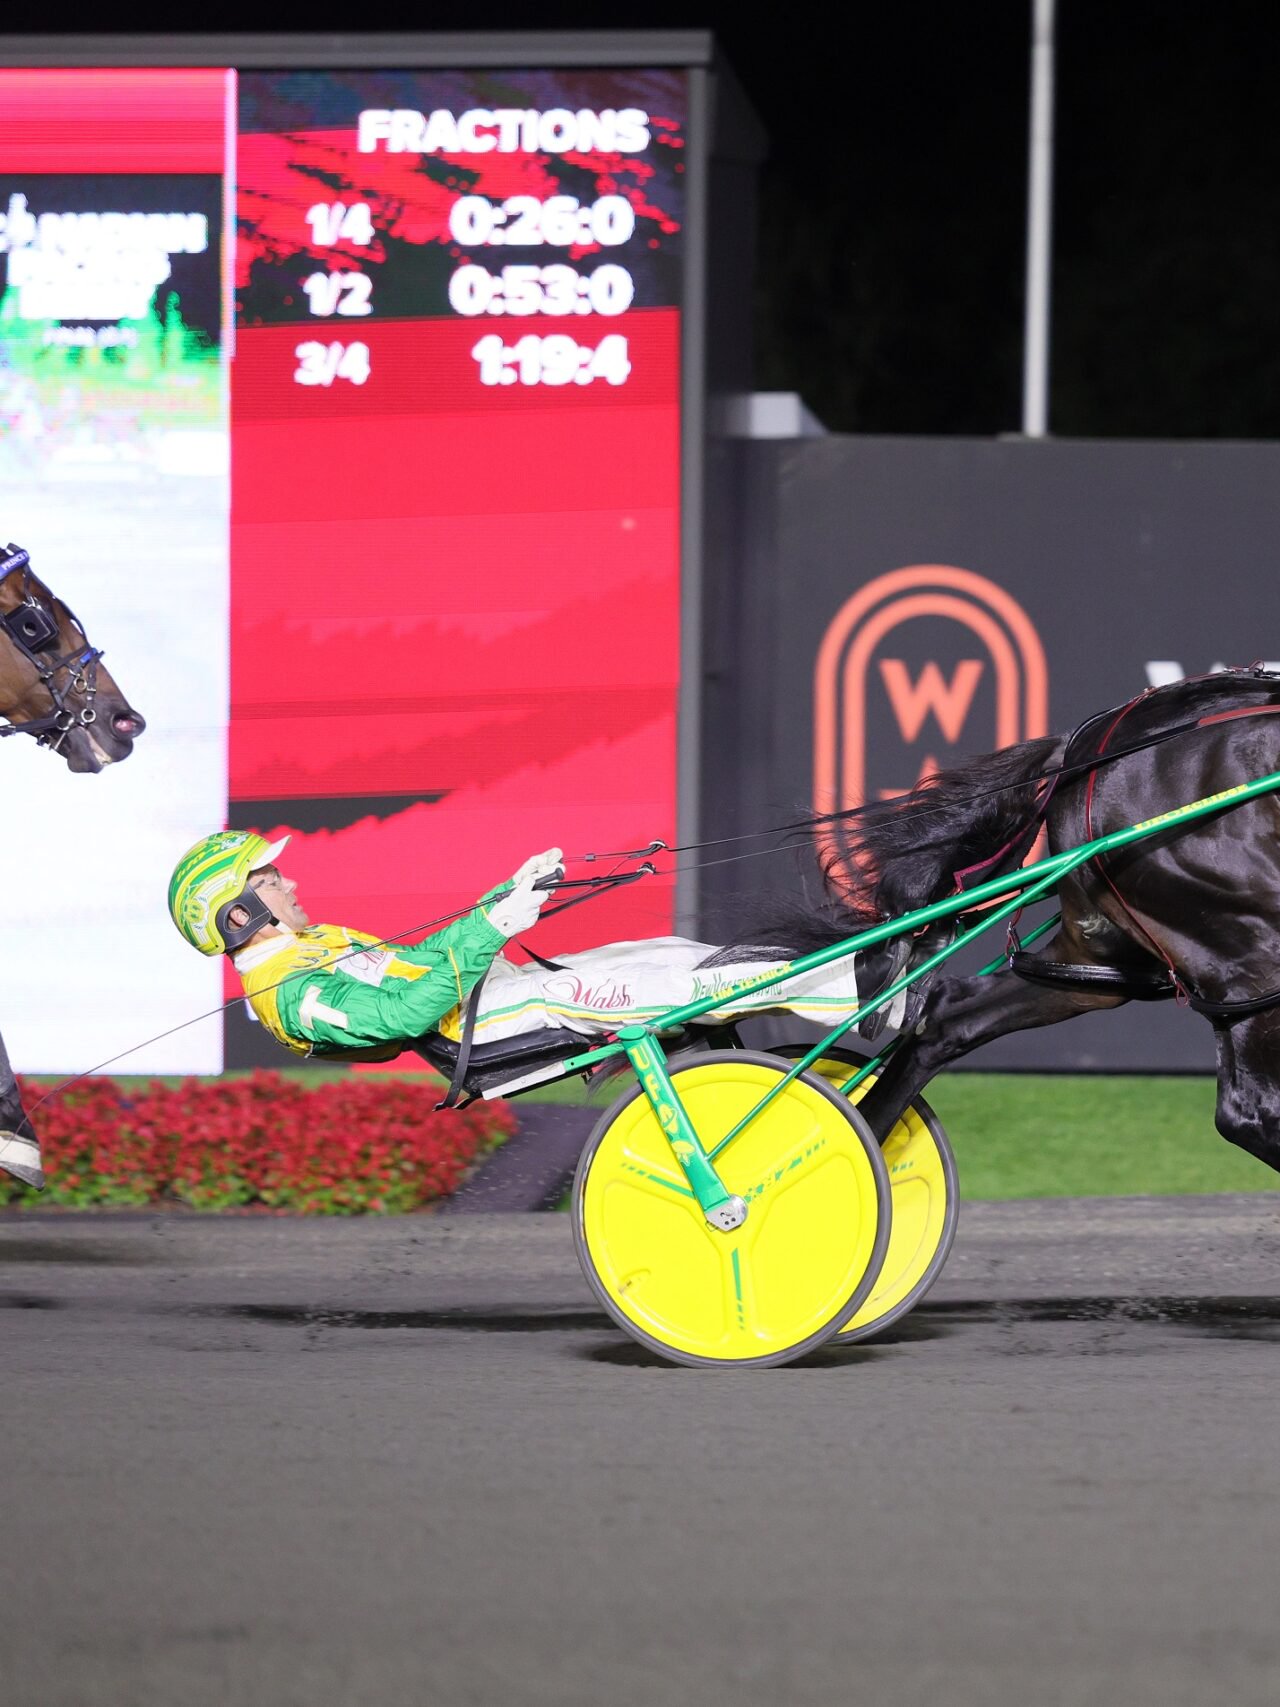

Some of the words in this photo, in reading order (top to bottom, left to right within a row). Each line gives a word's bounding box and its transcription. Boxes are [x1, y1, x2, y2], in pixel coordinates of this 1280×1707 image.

[358, 109, 650, 153] FRACTIONS
[305, 202, 374, 246] 1/4
[449, 196, 635, 246] 0:26:0
[303, 272, 373, 316] 1/2
[449, 265, 634, 316] 0:53:0
[294, 342, 371, 386] 3/4
[472, 335, 631, 386] 1:19:4
[879, 659, 985, 745] W
[543, 975, 634, 1009] Walsh
[740, 963, 793, 991] TETRICK
